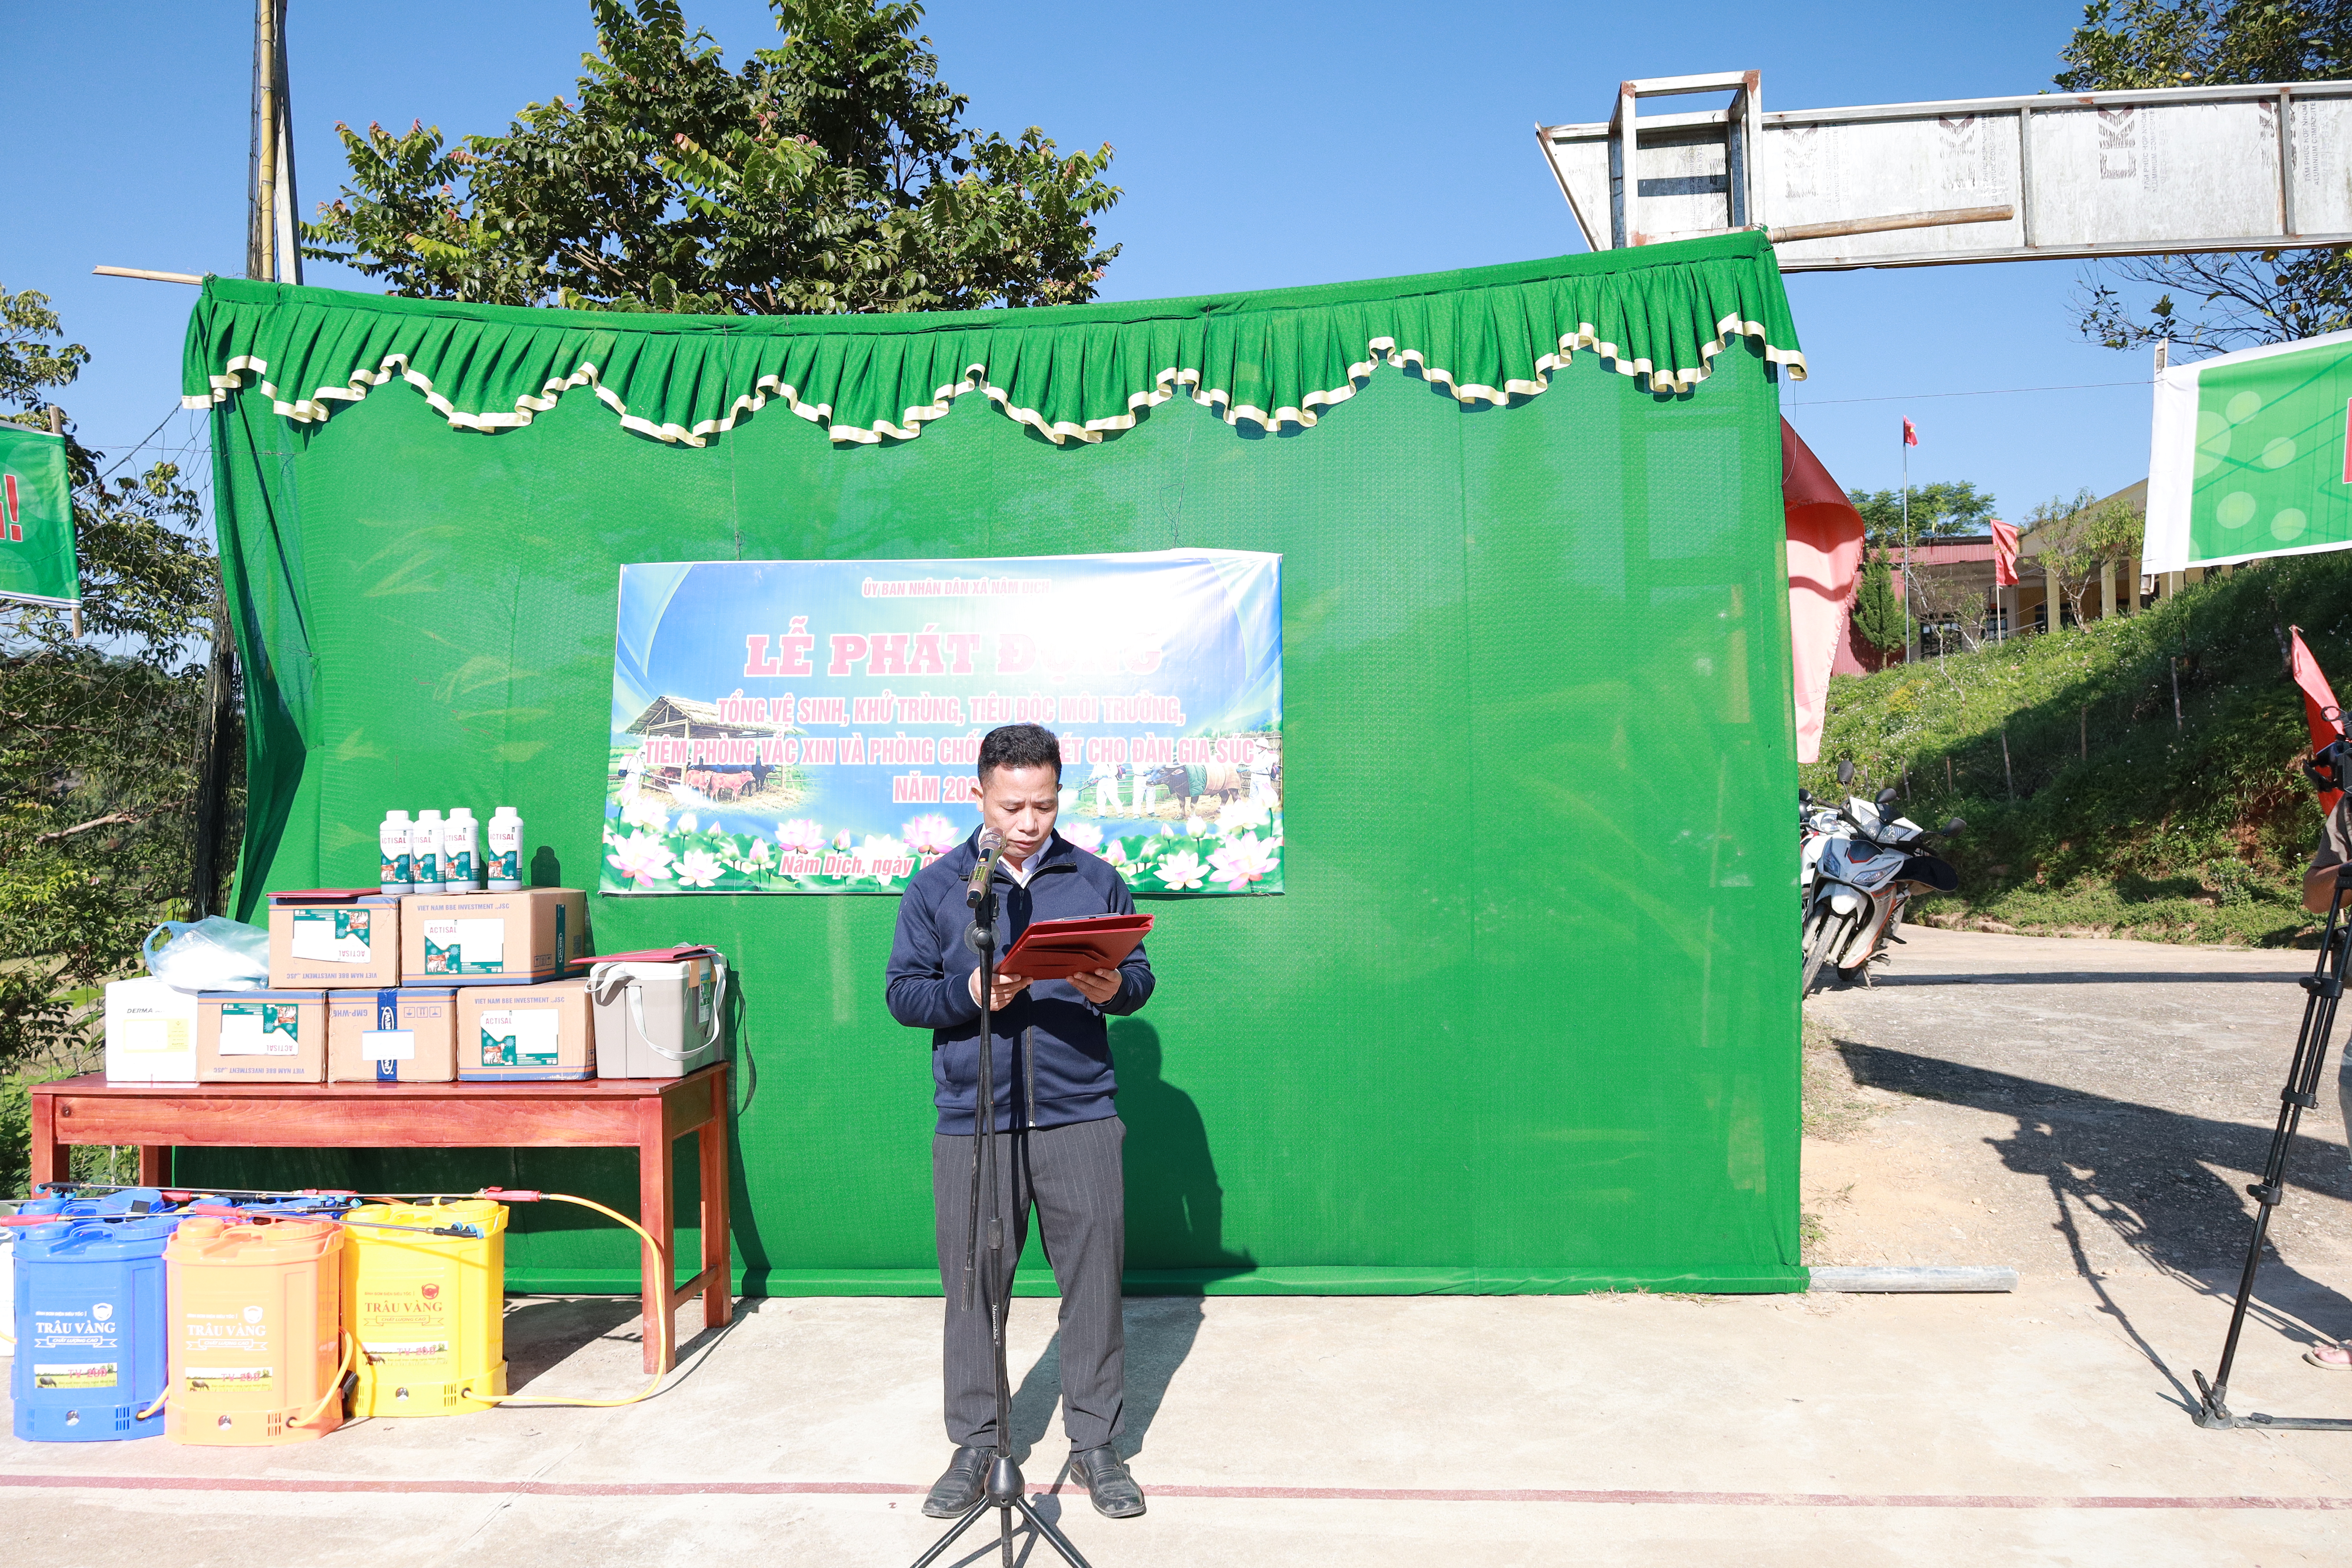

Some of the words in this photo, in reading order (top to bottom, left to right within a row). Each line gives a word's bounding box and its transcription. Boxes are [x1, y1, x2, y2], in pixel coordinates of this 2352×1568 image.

[864, 579, 878, 595] ỦY
[882, 583, 905, 595] BAN
[909, 580, 941, 594] NHÂN
[945, 579, 968, 594] DÂN
[972, 579, 987, 594] XÃ
[746, 618, 812, 675] LỄ
[830, 625, 980, 674] PHÁT
[718, 691, 765, 722] TỔNG
[772, 695, 792, 727] VỆ
[799, 700, 848, 724] SINH,
[855, 691, 896, 722] KHỬ
[897, 692, 964, 724] TRÙNG,
[971, 693, 1010, 721] TIÊU
[1061, 693, 1096, 721] MÔI
[1103, 692, 1184, 724] TRƯỜNG,
[645, 736, 686, 763] TIÊM
[693, 732, 754, 763] PHÒNG
[762, 732, 796, 763] VẮC
[801, 740, 833, 763] XIN
[841, 735, 864, 763] VÀ
[870, 734, 933, 763] PHÒNG
[1060, 735, 1082, 763] ÉT
[1089, 739, 1126, 763] CHO
[1132, 734, 1171, 763] ĐÀN
[1179, 739, 1210, 763] GIA
[1217, 735, 1254, 763] SÚC
[895, 773, 938, 801] NĂM
[945, 778, 980, 801] 202
[781, 856, 819, 877] Nậm
[824, 856, 865, 877] Dịch,
[872, 855, 912, 875] ngày
[365, 1300, 400, 1312] TRÂU
[403, 1300, 442, 1312] VÀNG
[36, 1320, 72, 1334] TRÂU
[75, 1320, 116, 1334] VÀNG
[187, 1323, 223, 1336] TRÂU
[226, 1323, 266, 1336] VÀNG
